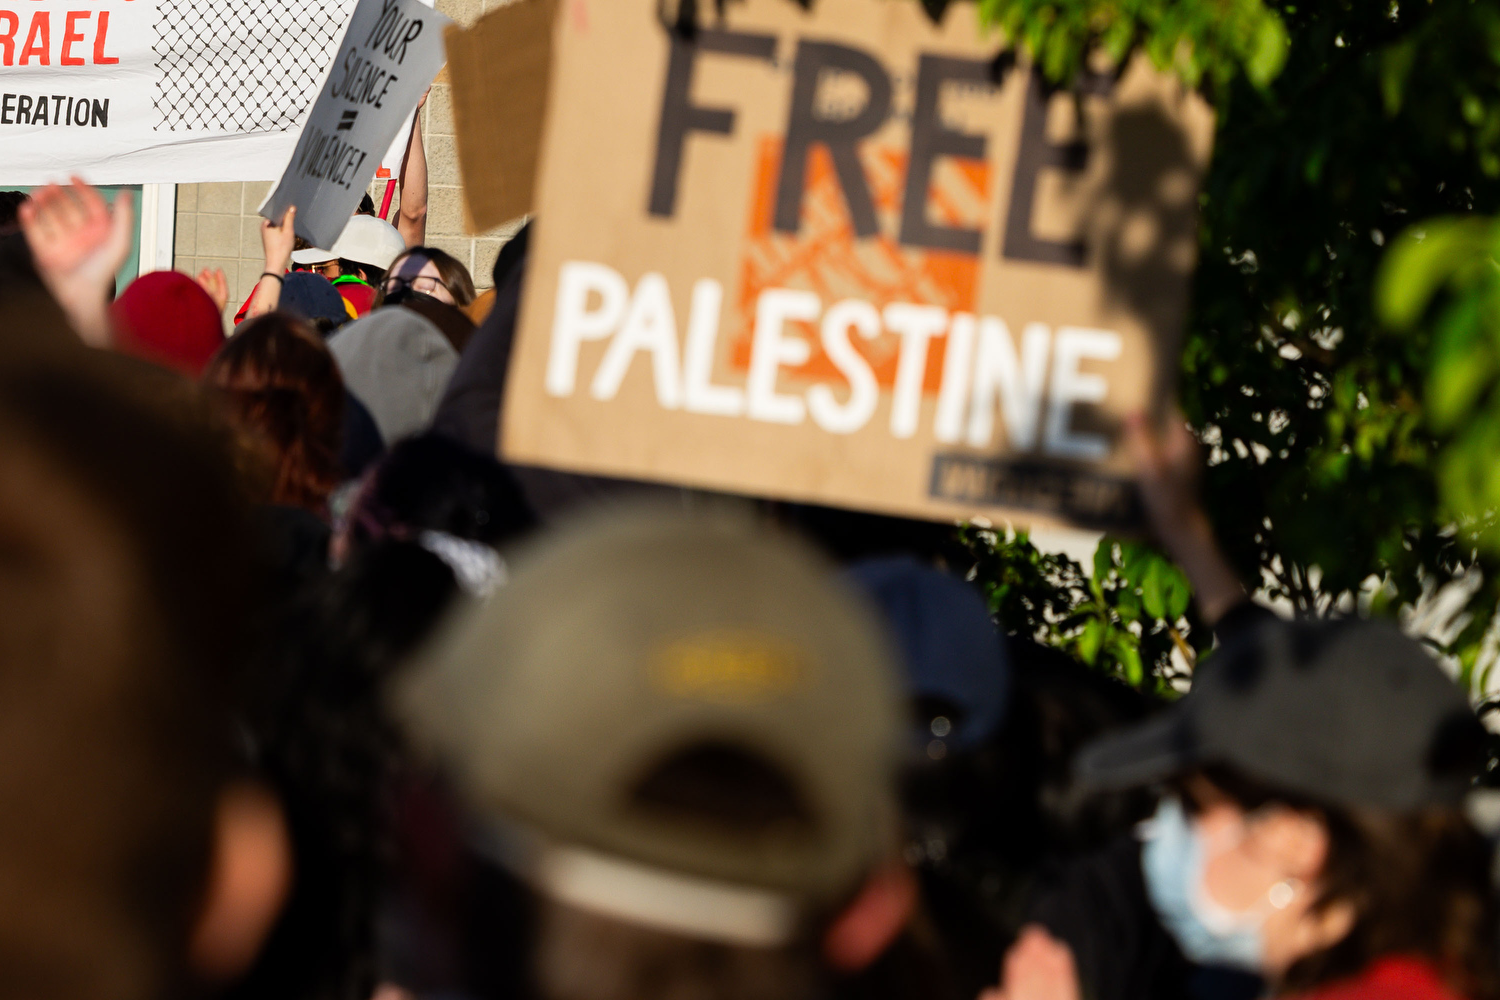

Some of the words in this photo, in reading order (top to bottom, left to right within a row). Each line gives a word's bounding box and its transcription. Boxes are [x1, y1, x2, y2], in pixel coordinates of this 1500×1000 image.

[331, 47, 398, 109] SILENCE
[296, 124, 368, 190] VIOLENCE!
[644, 26, 1106, 269] FREE
[544, 259, 1123, 459] PALESTINE
